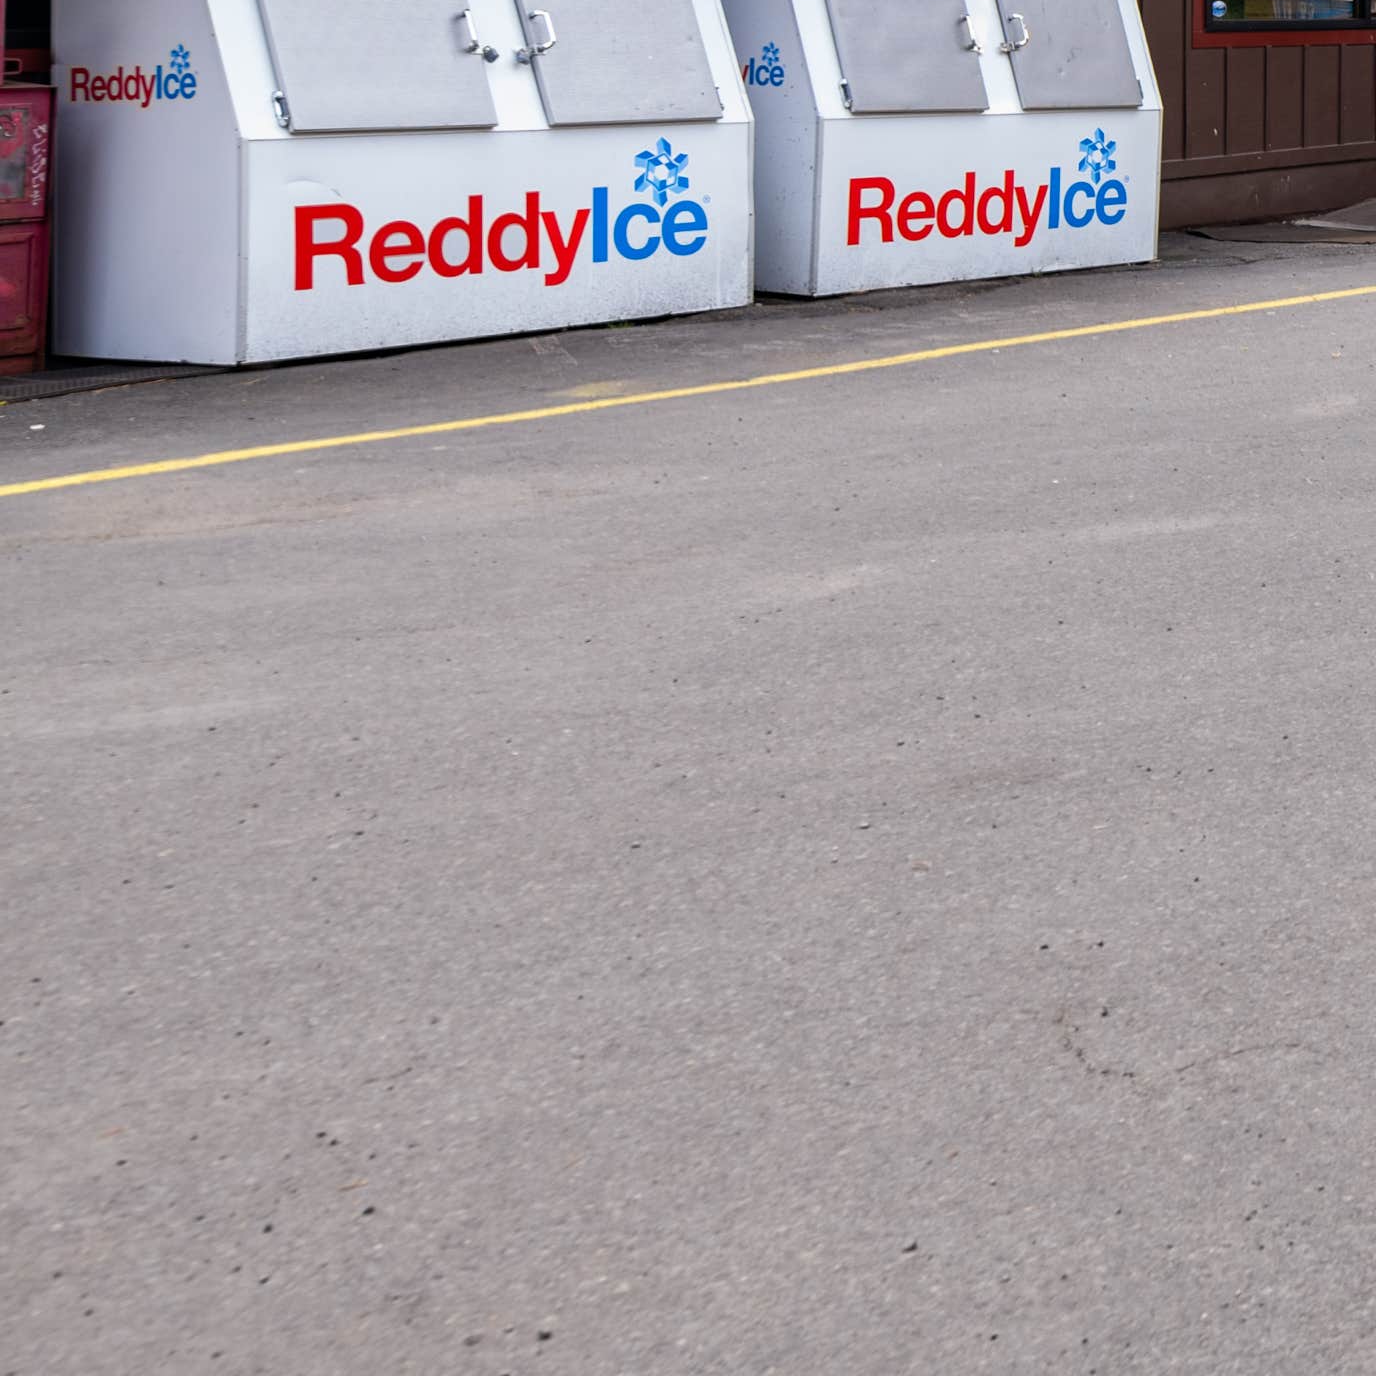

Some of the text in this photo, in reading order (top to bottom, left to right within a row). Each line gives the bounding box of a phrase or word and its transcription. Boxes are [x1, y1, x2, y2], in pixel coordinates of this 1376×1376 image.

[70, 65, 198, 109] ReddyIce
[293, 185, 710, 291] ReddyIce
[846, 166, 1129, 248] ReddyIce
